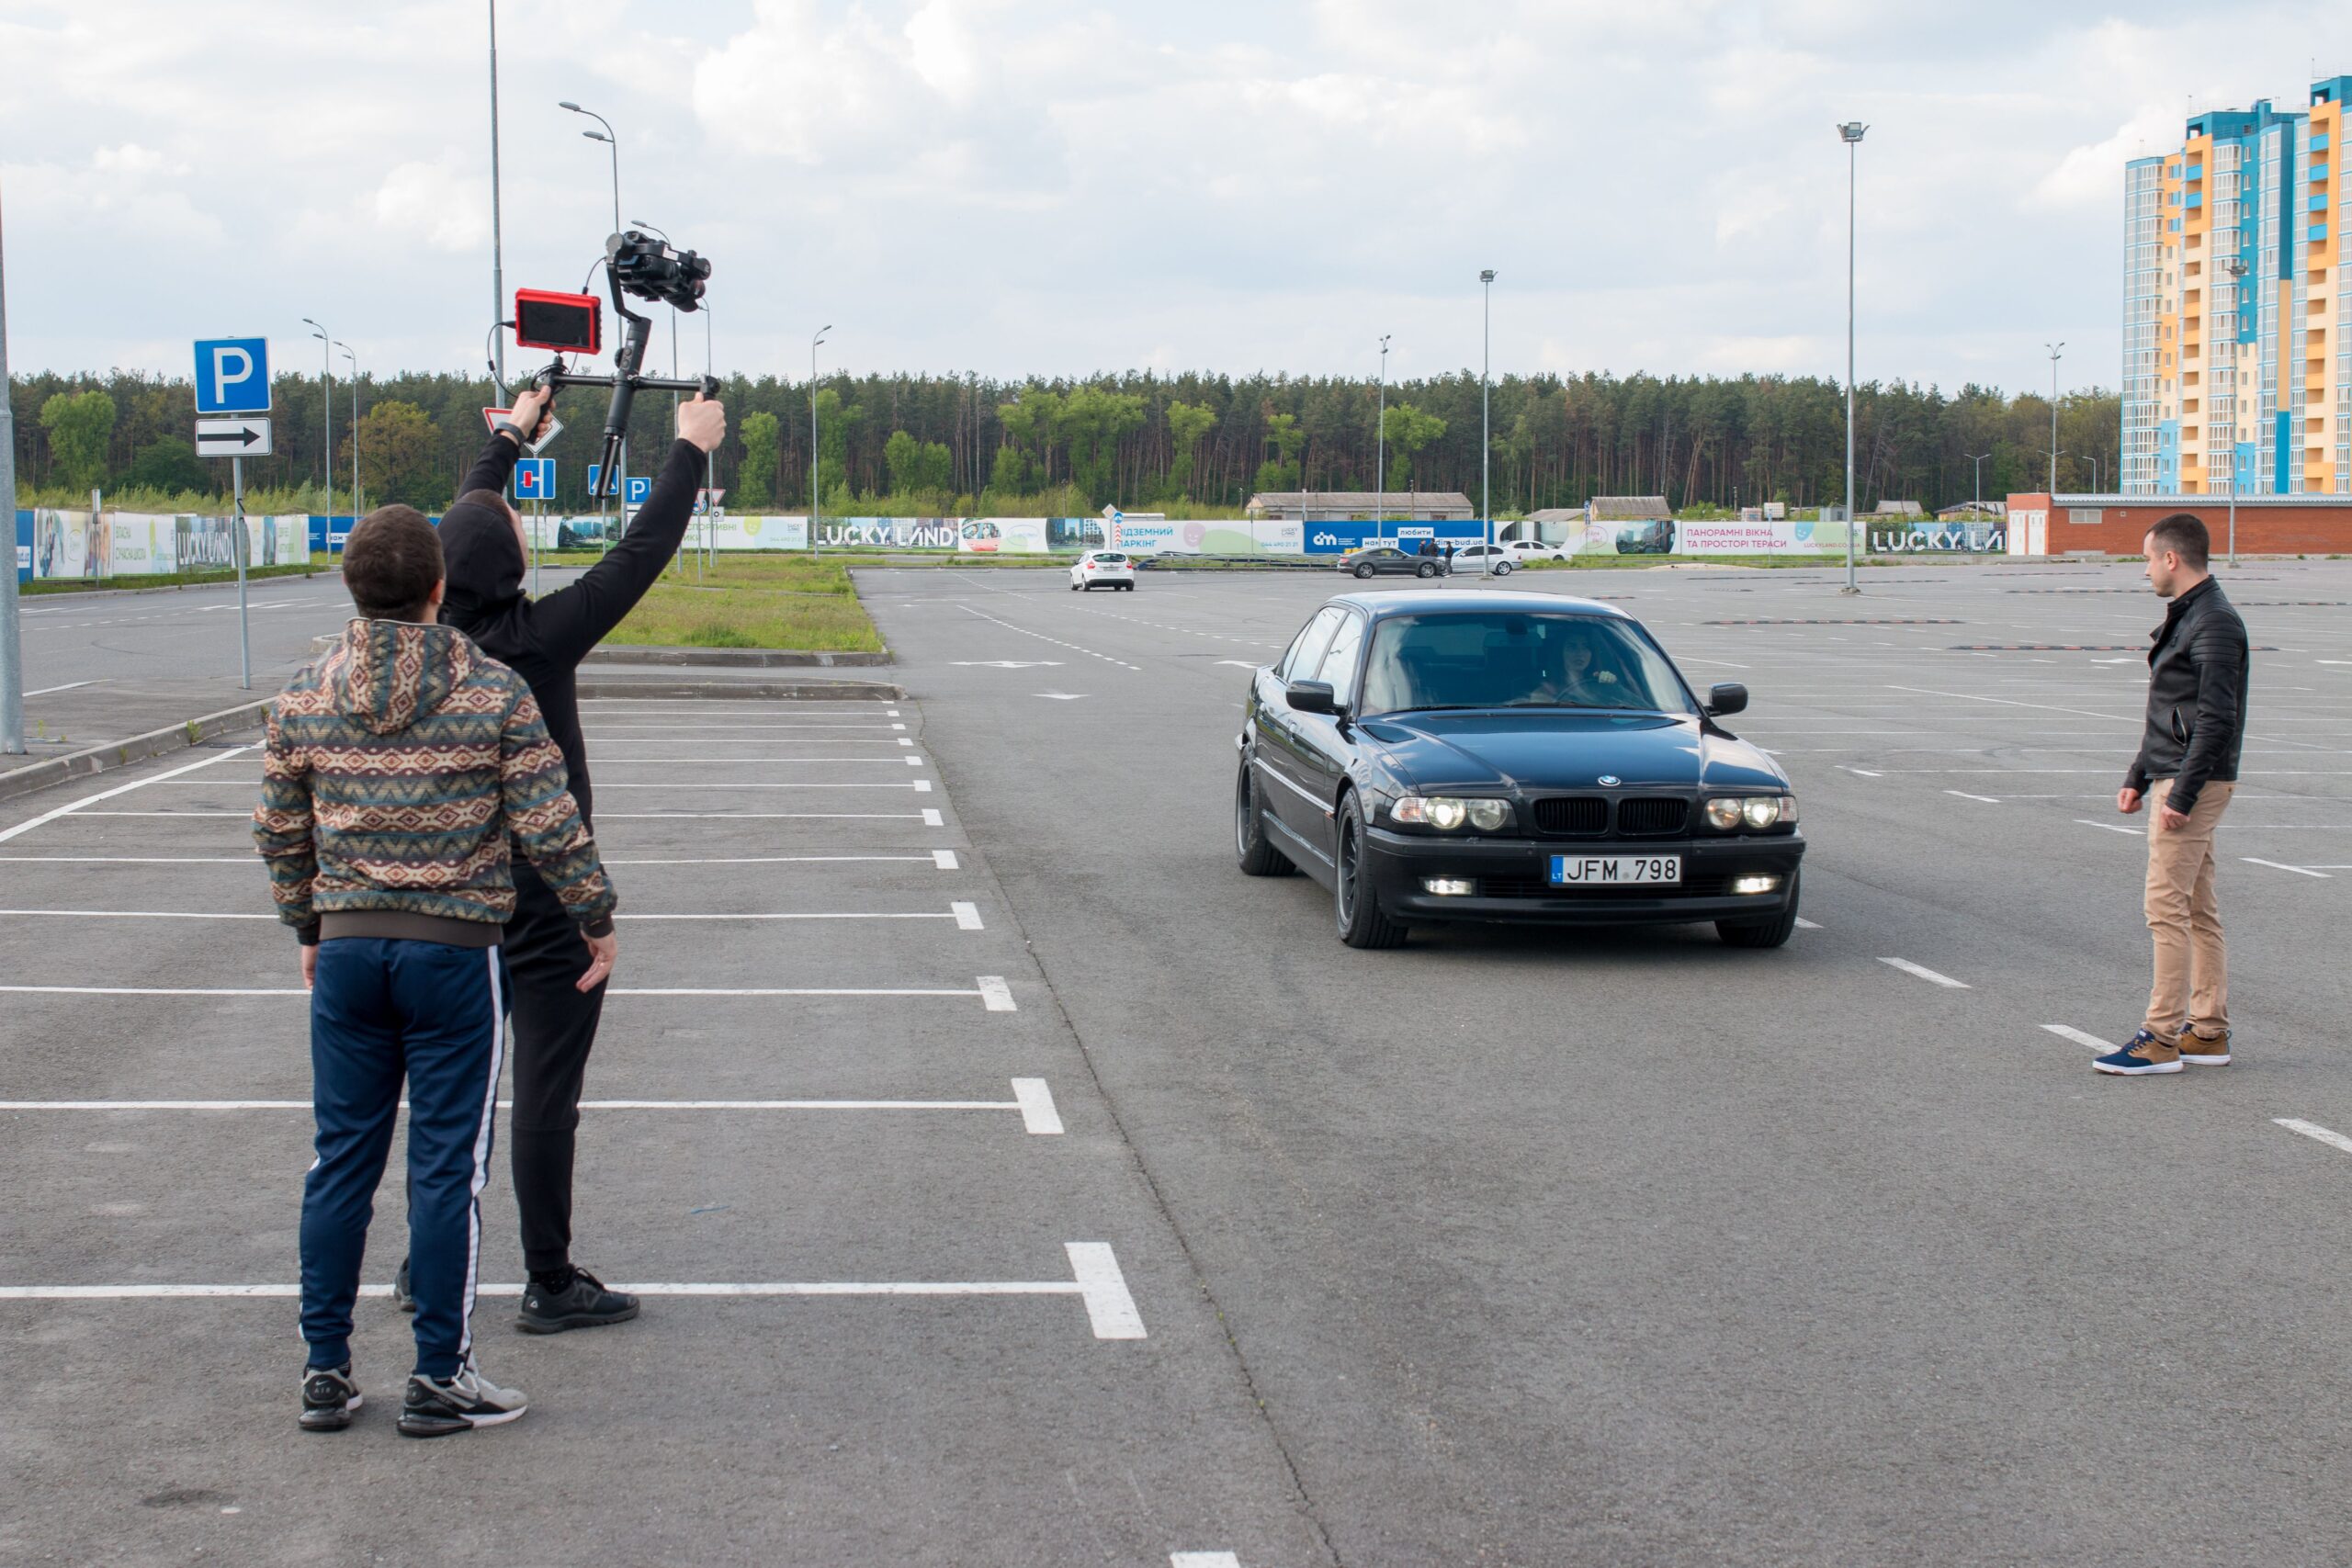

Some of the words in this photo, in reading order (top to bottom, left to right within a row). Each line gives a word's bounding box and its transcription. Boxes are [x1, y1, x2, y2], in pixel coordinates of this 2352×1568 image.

[213, 347, 253, 404] P
[631, 480, 646, 501] P
[897, 526, 954, 547] LAND
[1687, 528, 1743, 536] ПАНОРАМНІ
[1746, 528, 1773, 536] ВІКНА
[1872, 531, 1962, 551] LUCKY
[1687, 540, 1698, 548] ТА
[1701, 540, 1749, 548] ПРОСТОРІ
[1752, 540, 1787, 548] ТЕРАСИ
[1566, 860, 1617, 881] JFM
[1635, 859, 1677, 881] 798
